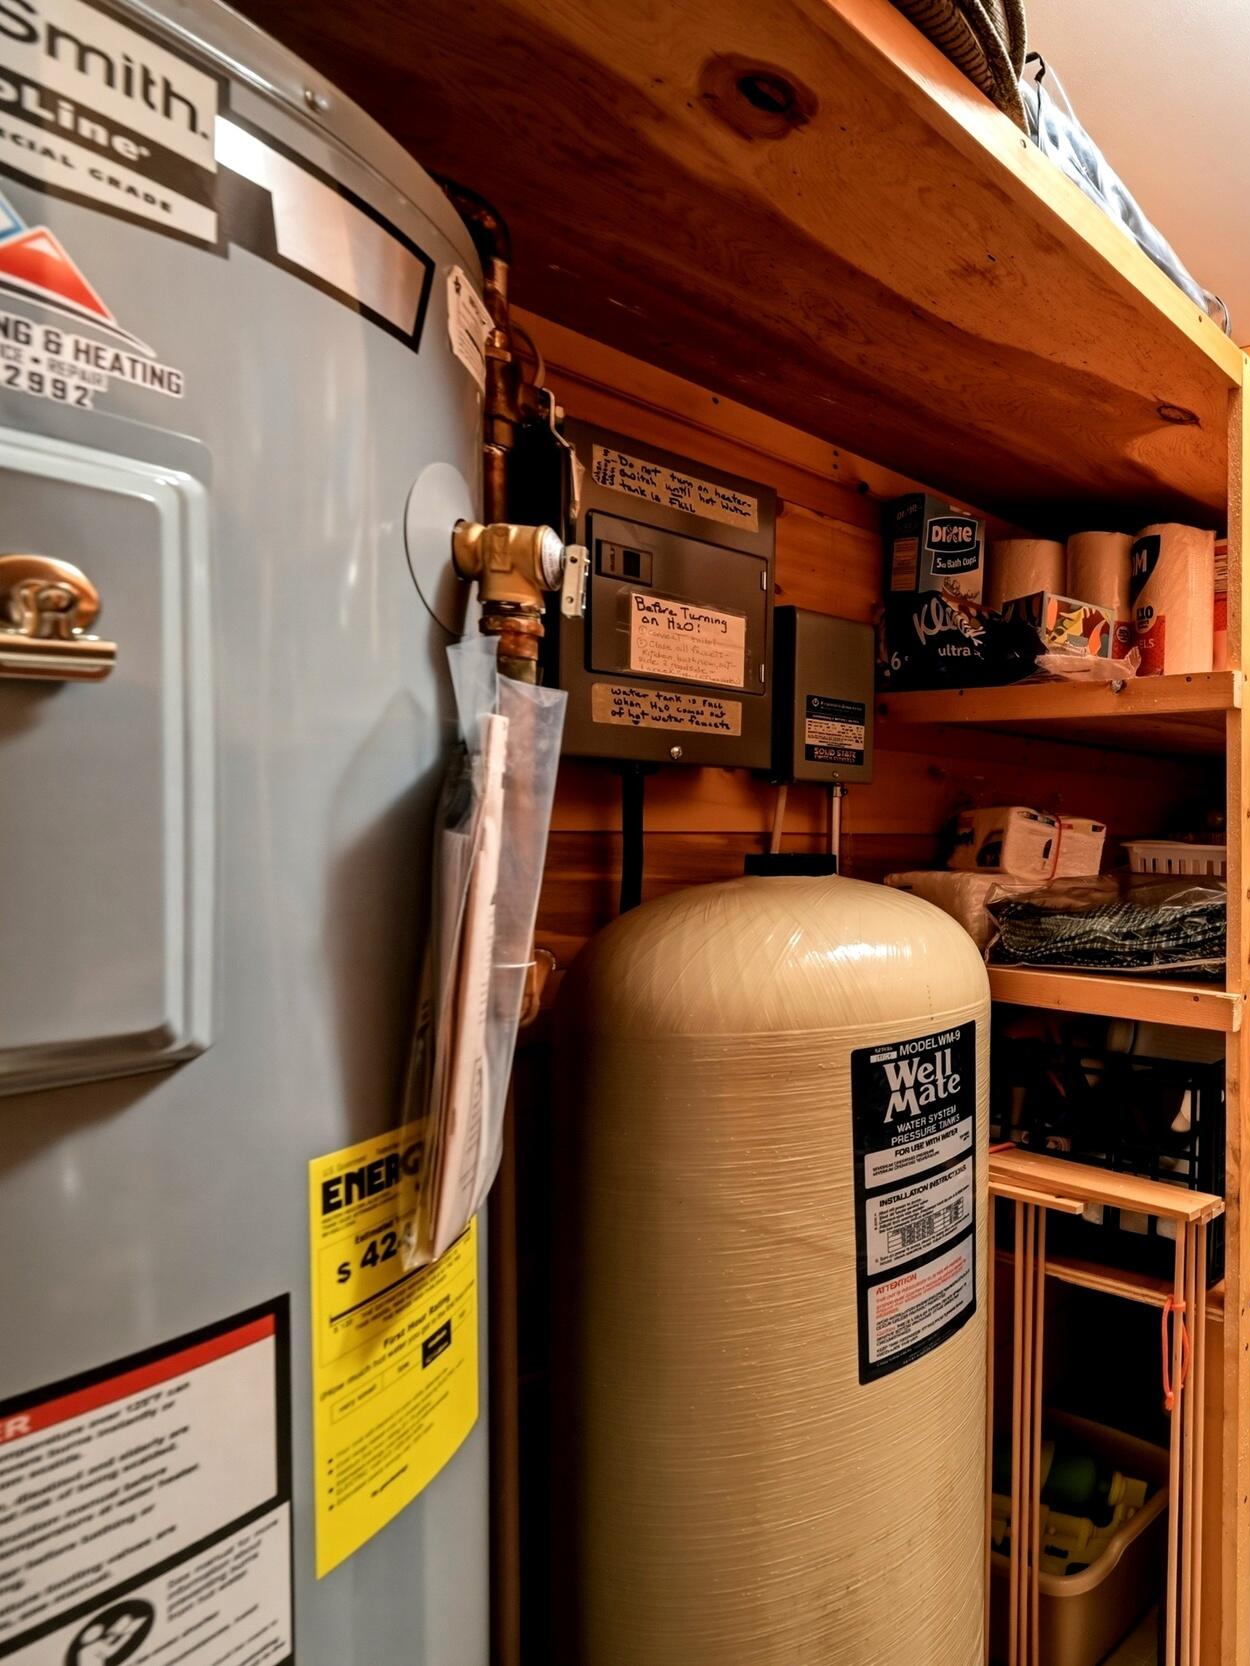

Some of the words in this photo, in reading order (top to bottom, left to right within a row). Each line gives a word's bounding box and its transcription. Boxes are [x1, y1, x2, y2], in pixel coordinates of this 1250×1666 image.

[88, 167, 173, 213] GRADE
[73, 338, 183, 396] HEATING
[618, 454, 634, 469] Do
[641, 466, 661, 477] not
[670, 473, 694, 489] turn
[698, 485, 709, 494] on
[619, 480, 647, 497] tank
[699, 494, 716, 506] hot
[634, 596, 677, 616] Before
[680, 607, 727, 633] Turning
[641, 616, 659, 626] on
[891, 652, 901, 670] 6
[938, 643, 972, 657] ultra
[655, 692, 682, 703] tank
[611, 708, 625, 718] of
[628, 709, 649, 720] hot
[900, 1039, 938, 1056] MODEL
[938, 1030, 961, 1046] WM-9
[883, 1048, 953, 1092] Well
[883, 1073, 961, 1124] Mate
[897, 1115, 927, 1134] WATER
[929, 1105, 957, 1124] SYSTEM
[891, 1123, 937, 1147] PRESSURE
[895, 1146, 911, 1157] FOR
[912, 1142, 924, 1153] USE
[926, 1136, 941, 1149] WITH
[880, 1183, 928, 1208] INSTALLATION
[929, 1164, 967, 1190] INSTRUCTIONS
[876, 1272, 917, 1295] ATTENTION
